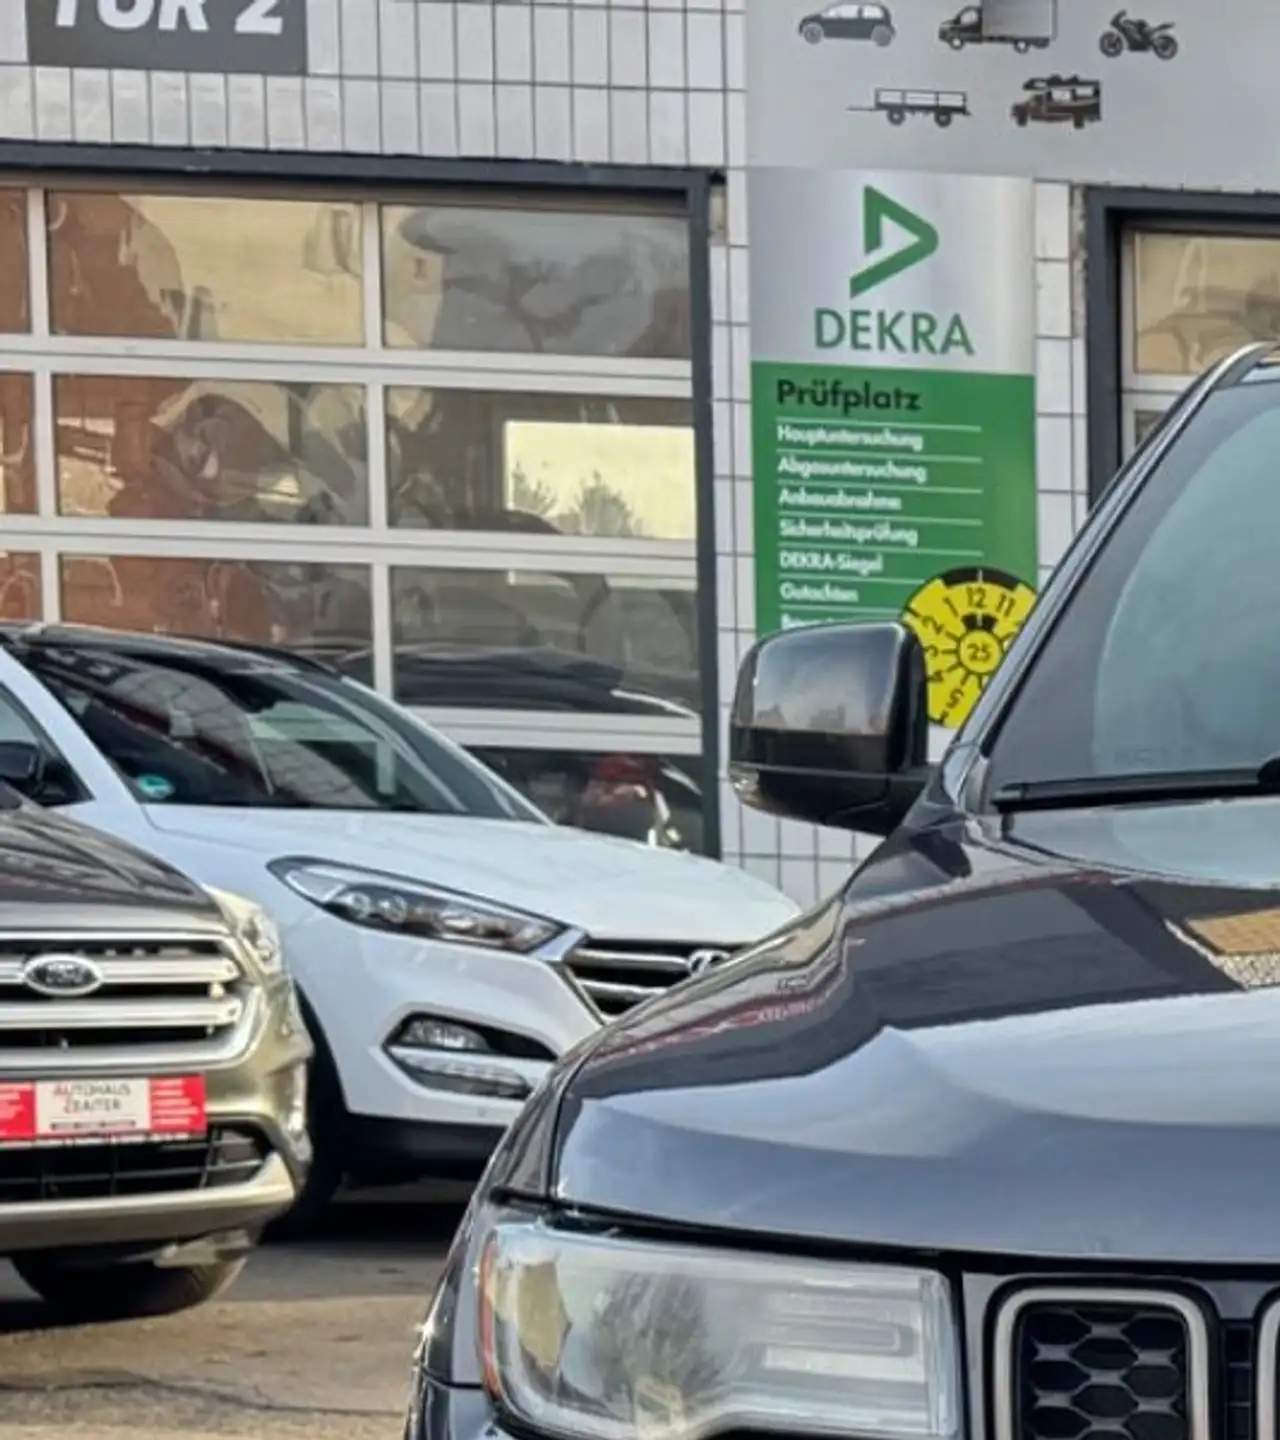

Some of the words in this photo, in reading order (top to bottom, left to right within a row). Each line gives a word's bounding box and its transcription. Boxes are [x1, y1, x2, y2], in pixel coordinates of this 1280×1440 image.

[814, 307, 975, 356] DEKRA
[776, 379, 922, 415] Prüfplatz
[780, 551, 883, 576] DEKRA-Siegel
[942, 596, 959, 617] 1
[966, 586, 987, 608] 12
[996, 594, 1016, 617] 11
[922, 616, 944, 636] 2
[967, 643, 992, 662] 25
